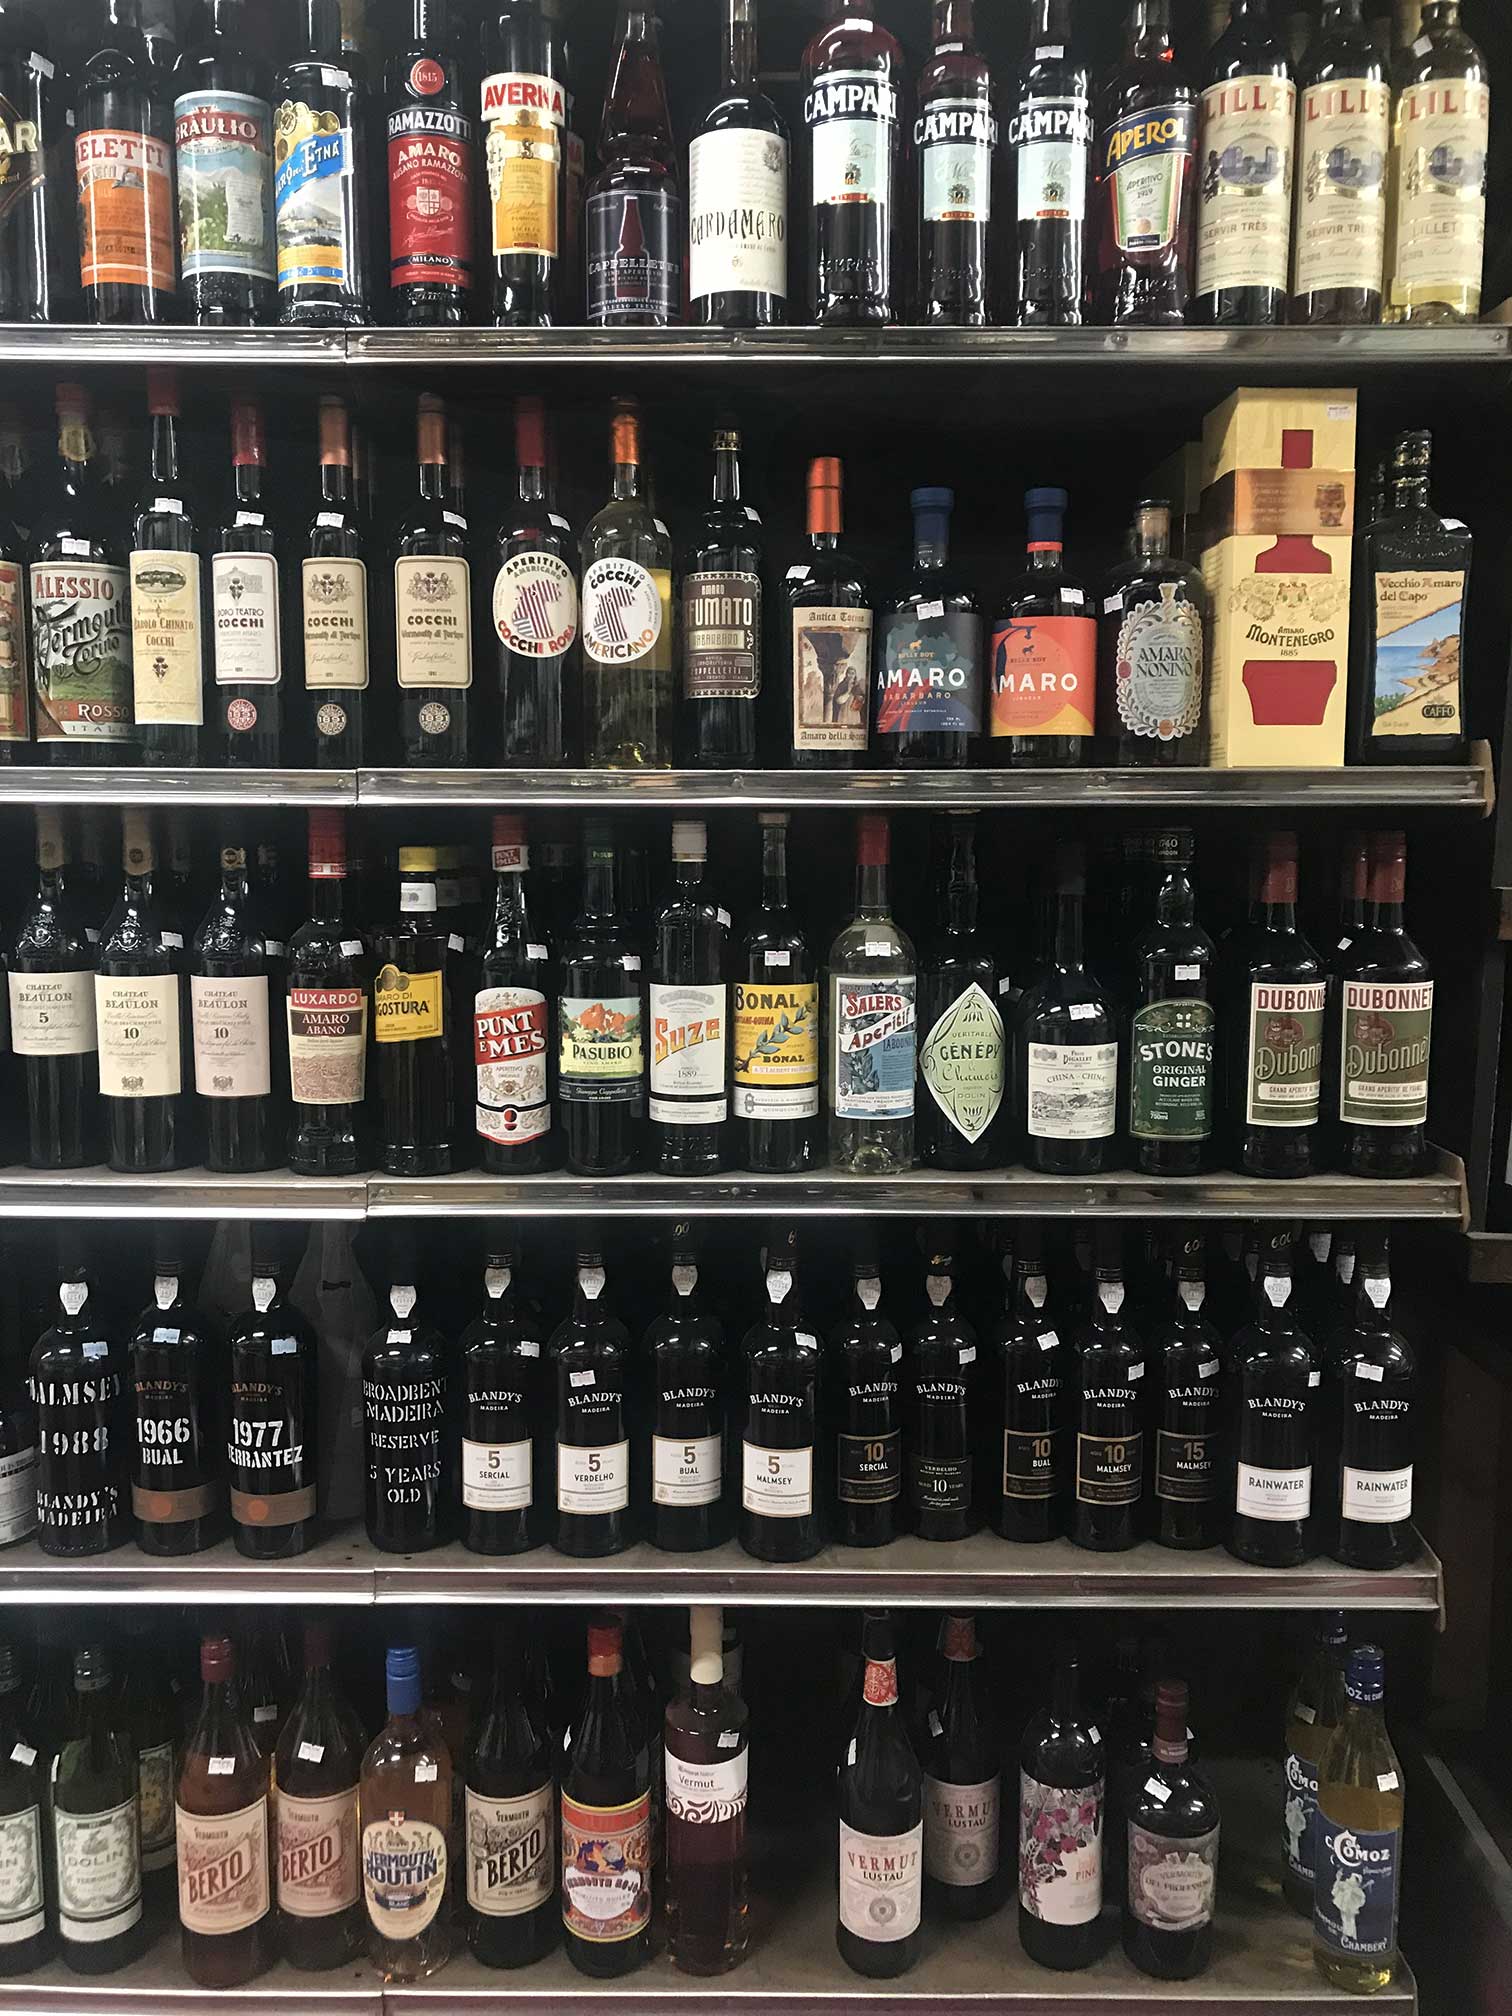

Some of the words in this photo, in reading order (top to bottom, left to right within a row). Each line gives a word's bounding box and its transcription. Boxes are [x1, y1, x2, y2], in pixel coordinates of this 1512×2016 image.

[418, 71, 438, 82] 1815
[484, 82, 563, 113] AVERNA
[804, 85, 897, 123] CAMPARI
[388, 111, 472, 140] RAMAZZOTTI
[913, 112, 1000, 145] CAMPARI
[1008, 110, 1094, 144] CAMPARI
[1106, 117, 1187, 168] APEROL
[77, 138, 165, 168] ELETTI
[398, 142, 461, 167] AMARO
[690, 208, 785, 247] CARDAMARO
[412, 255, 450, 265] MILANO
[505, 555, 569, 578] APERITIVO
[588, 562, 646, 582] APERITIVO
[35, 573, 115, 601] ALESSIO
[590, 570, 642, 590] COCCHI
[1379, 577, 1420, 588] Vecchio
[1422, 577, 1462, 588] Amaro
[1379, 590, 1397, 601] del
[1398, 590, 1428, 604] Capo
[159, 617, 194, 631] CHINATO
[218, 618, 265, 629] COCCHI
[307, 616, 355, 628] COCCHI
[407, 615, 458, 627] COCCHI
[145, 633, 175, 647] COCCHI
[497, 619, 544, 655] COCCHI
[583, 627, 655, 660] AMERICANO
[1246, 623, 1336, 649] MONTENEGRO
[1136, 645, 1193, 662] AMARO
[877, 667, 966, 690] AMARO
[1135, 662, 1193, 679] NONINO
[78, 703, 130, 724] ROSSO
[1423, 705, 1455, 717] CAFFO
[18, 992, 73, 1002] BEAULON
[105, 999, 159, 1009] BEAULON
[198, 999, 248, 1009] BEAULON
[293, 991, 358, 1005] LUXARDO
[735, 985, 800, 1011] BONAL
[846, 991, 903, 1017] SALERS
[38, 1011, 50, 1024] 5
[301, 1014, 350, 1025] AMARO
[476, 1010, 535, 1039] PUNT
[123, 1027, 140, 1039] 10
[213, 1027, 230, 1039] 10
[305, 1025, 346, 1035] ABANO
[479, 1039, 488, 1053] E
[488, 1031, 547, 1059] MES
[654, 1017, 721, 1067] Suze
[572, 1045, 633, 1061] PASUBIO
[762, 1054, 805, 1064] BONAL
[939, 1041, 1000, 1061] GÉNÉPY
[1139, 1041, 1214, 1062] STONE'S
[677, 1069, 698, 1079] 1889
[1046, 1072, 1076, 1084] CHINA
[1152, 1064, 1207, 1076] ORIGINAL
[1152, 1076, 1206, 1088] GINGER
[362, 1375, 449, 1402] BROADBENT
[467, 1390, 523, 1404] BLANDY'S
[661, 1387, 717, 1402] BLANDY'S
[848, 1381, 899, 1397] BLANDY'S
[916, 1382, 968, 1397] BLANDY'S
[1082, 1388, 1138, 1401] BLANDY'S
[567, 1391, 623, 1408] BLANDY'S
[749, 1393, 804, 1409] BLANDY'S
[1247, 1397, 1306, 1412] BLANDY'S
[1353, 1399, 1410, 1413] BLANDY'S
[366, 1400, 445, 1424] MADEIRA
[136, 1417, 191, 1445] 1966
[232, 1420, 284, 1448] 1977
[370, 1429, 440, 1450] RESERVE
[41, 1427, 109, 1456] 1988
[1031, 1438, 1052, 1458] 10
[142, 1447, 184, 1466] BUAL
[683, 1445, 697, 1465] 5
[863, 1442, 885, 1462] 10
[1103, 1444, 1125, 1465] 10
[1183, 1441, 1205, 1460] 15
[487, 1450, 501, 1470] 5
[587, 1453, 601, 1473] 5
[767, 1455, 781, 1475] 5
[858, 1462, 889, 1472] SERCIAL
[1032, 1459, 1052, 1468] BUAL
[1176, 1460, 1212, 1470] MALMSEY
[369, 1463, 378, 1480] 5
[384, 1460, 443, 1485] YEARS
[479, 1470, 511, 1481] SERCIAL
[574, 1473, 615, 1482] VERDELHO
[679, 1466, 700, 1475] BUAL
[1096, 1464, 1132, 1474] MALMSEY
[756, 1474, 793, 1486] MALMSEY
[1248, 1476, 1305, 1492] RAINWATER
[1356, 1478, 1409, 1492] RAINWATER
[386, 1487, 422, 1505] OLD
[678, 1774, 715, 1789] Vermut
[495, 1808, 530, 1823] VERMOUTH
[947, 1816, 987, 1829] LUSTAU
[68, 1849, 124, 1867] DOLIN
[281, 1834, 333, 1884] BERTO
[486, 1828, 541, 1889] BERTO
[847, 1851, 918, 1871] VERMUT
[188, 1849, 244, 1905] BERTO
[862, 1869, 904, 1882] LUSTAU
